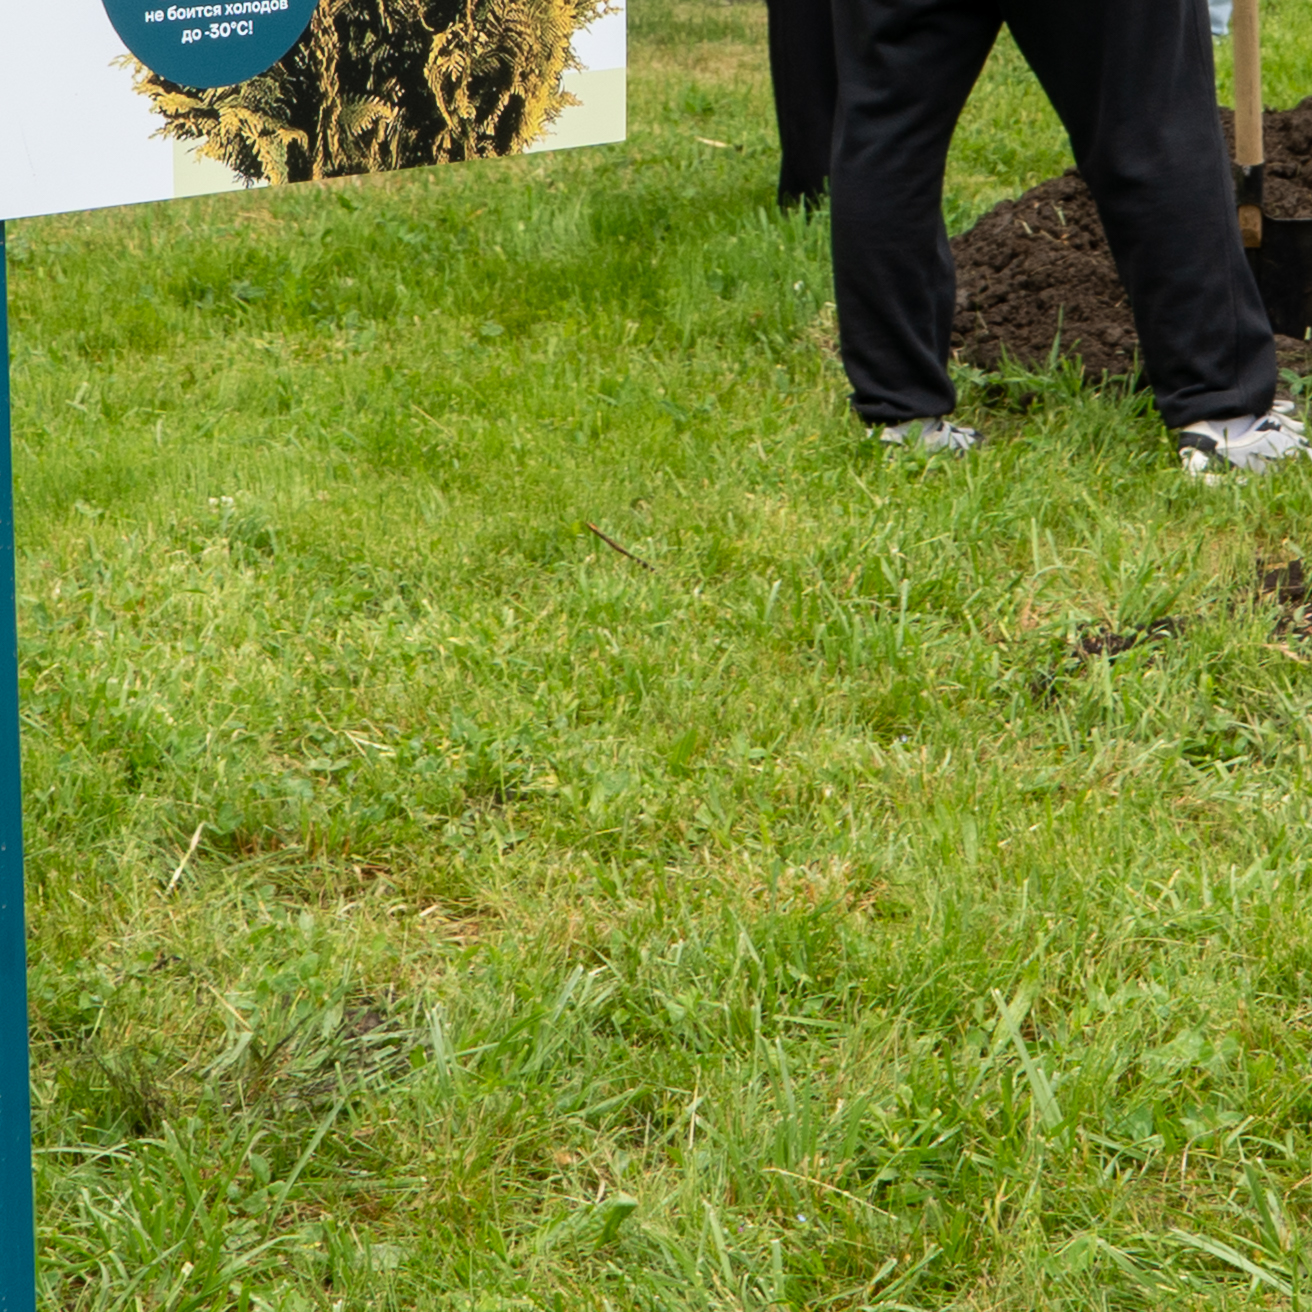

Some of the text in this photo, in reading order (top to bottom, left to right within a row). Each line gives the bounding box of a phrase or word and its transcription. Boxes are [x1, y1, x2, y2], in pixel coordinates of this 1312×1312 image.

[144, 9, 164, 22] не
[167, 3, 222, 21] боится
[181, 28, 202, 44] до
